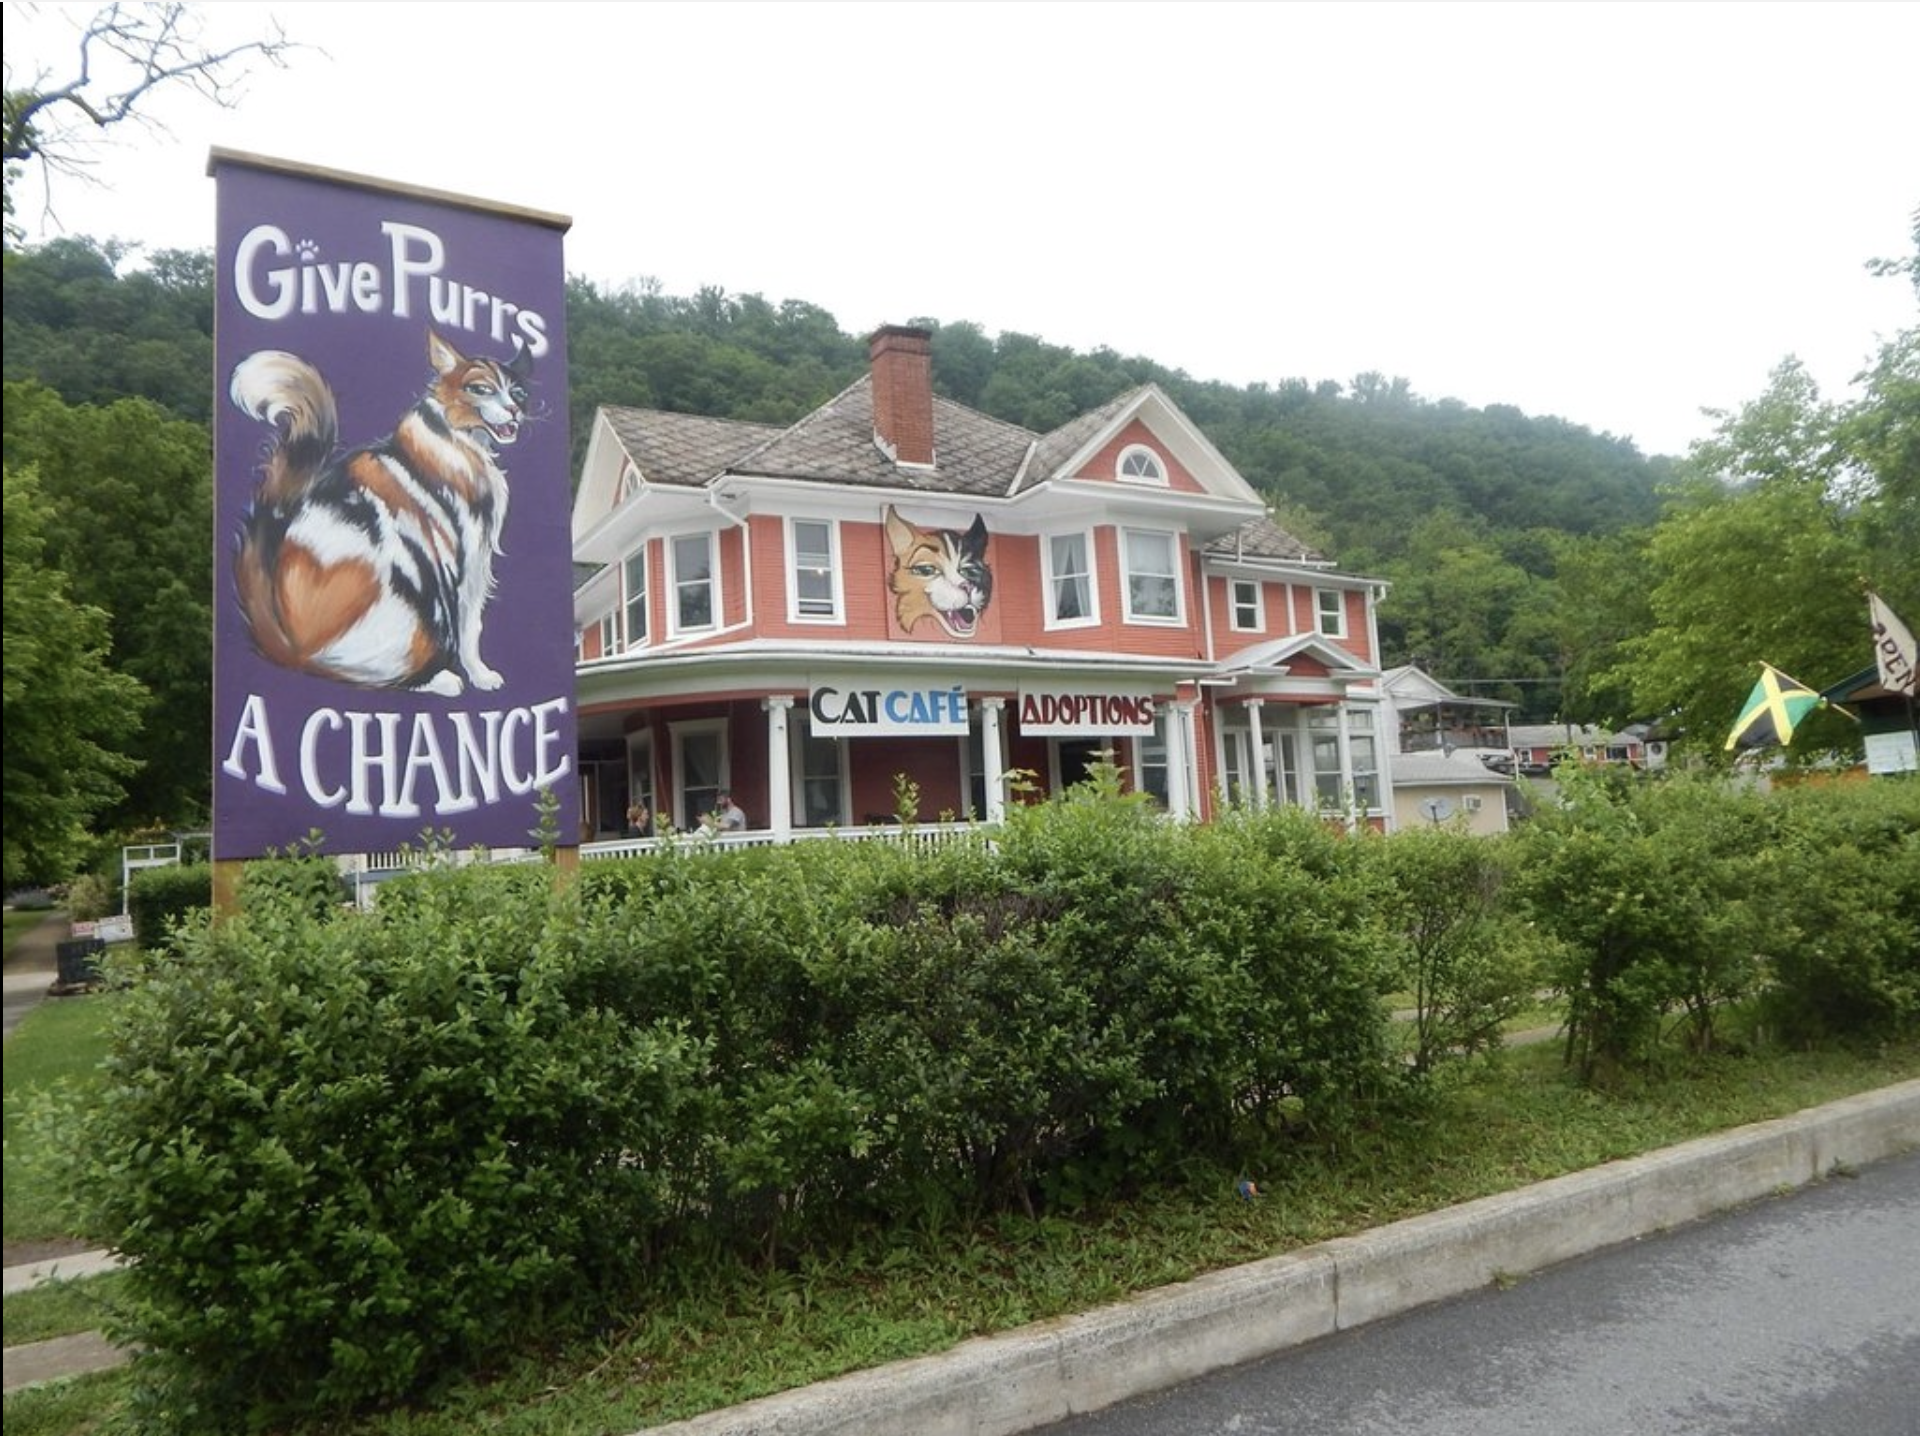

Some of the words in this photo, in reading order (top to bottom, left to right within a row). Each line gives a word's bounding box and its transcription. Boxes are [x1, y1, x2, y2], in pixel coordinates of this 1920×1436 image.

[235, 224, 382, 320] Give
[381, 221, 549, 358] Purrs
[811, 686, 881, 724] CAT
[885, 685, 967, 724] CAFÉ
[1020, 693, 1154, 726] ADOPTIONS
[223, 693, 286, 795] A
[300, 696, 571, 817] CHANCE
